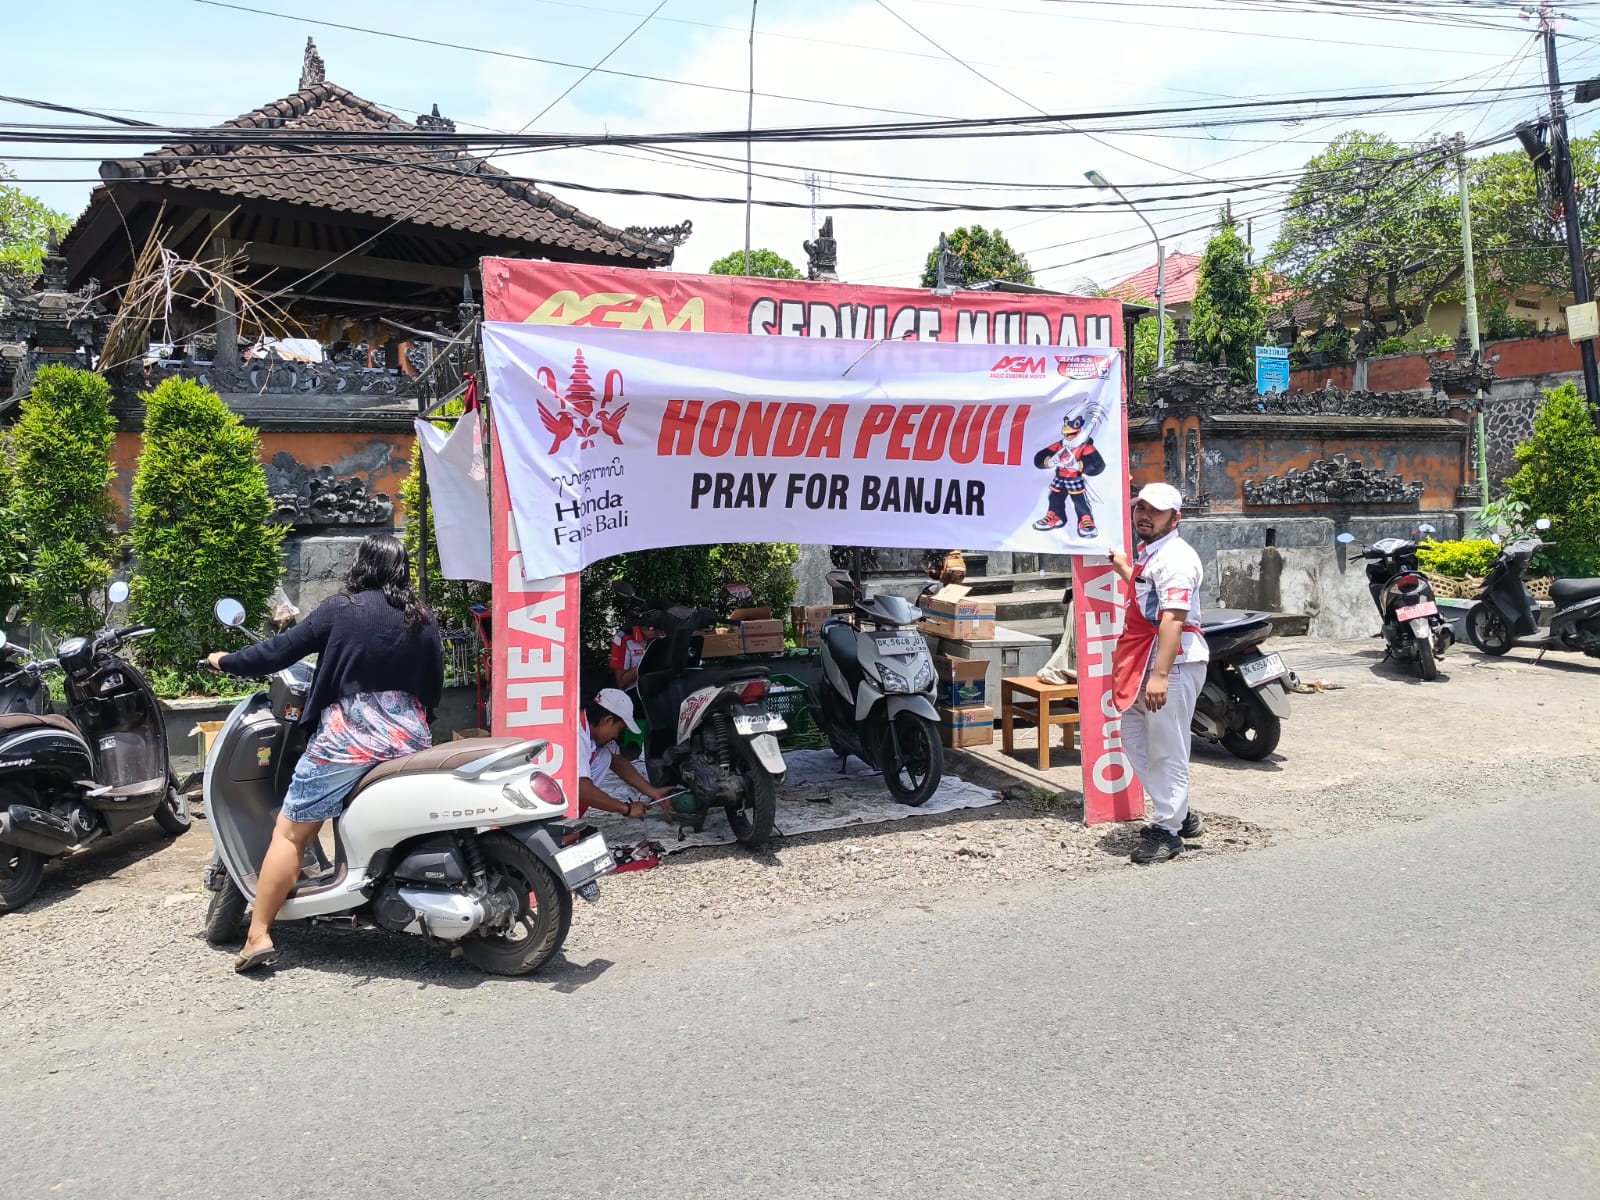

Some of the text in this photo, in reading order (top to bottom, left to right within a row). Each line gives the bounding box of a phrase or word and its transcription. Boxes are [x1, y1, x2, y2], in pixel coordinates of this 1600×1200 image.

[990, 356, 1046, 373] AGM
[656, 399, 1033, 466] HONDA PEDULI
[555, 490, 624, 522] Honda
[690, 473, 986, 516] PRAY FOR BANJAR
[554, 510, 628, 545] Fans Bali
[507, 511, 566, 728] HEAR
